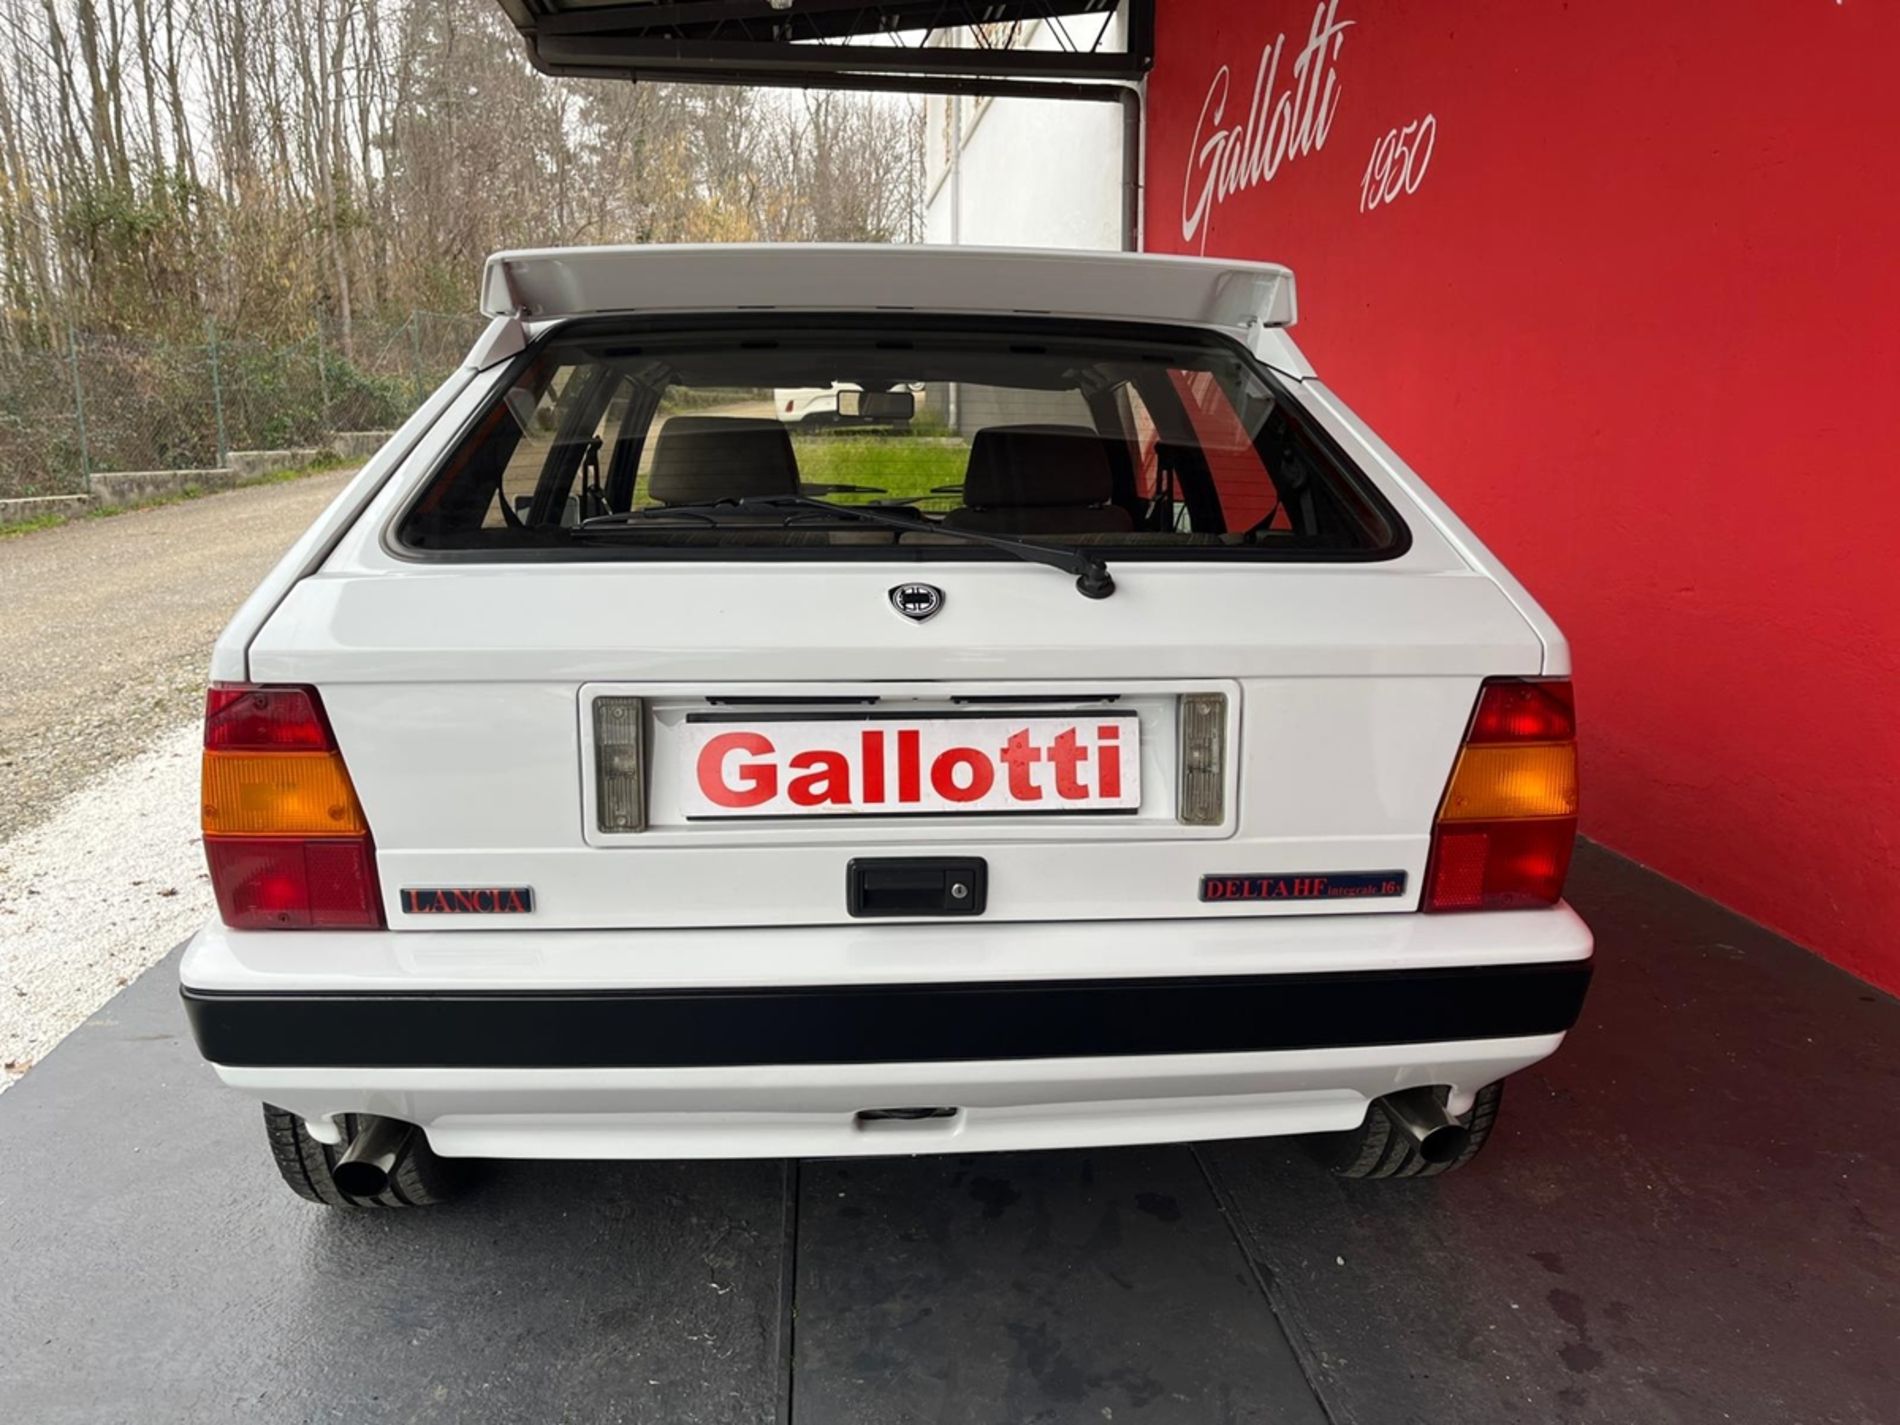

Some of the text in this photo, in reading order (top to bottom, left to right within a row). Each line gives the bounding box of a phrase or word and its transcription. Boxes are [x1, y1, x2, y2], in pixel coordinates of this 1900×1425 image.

[1182, 0, 1356, 257] Gallotti
[1360, 113, 1436, 213] 1950
[697, 725, 1120, 808] Gallotti
[409, 888, 525, 913] LANCIA
[1206, 879, 1288, 898] DELTA
[1293, 878, 1327, 897] HF
